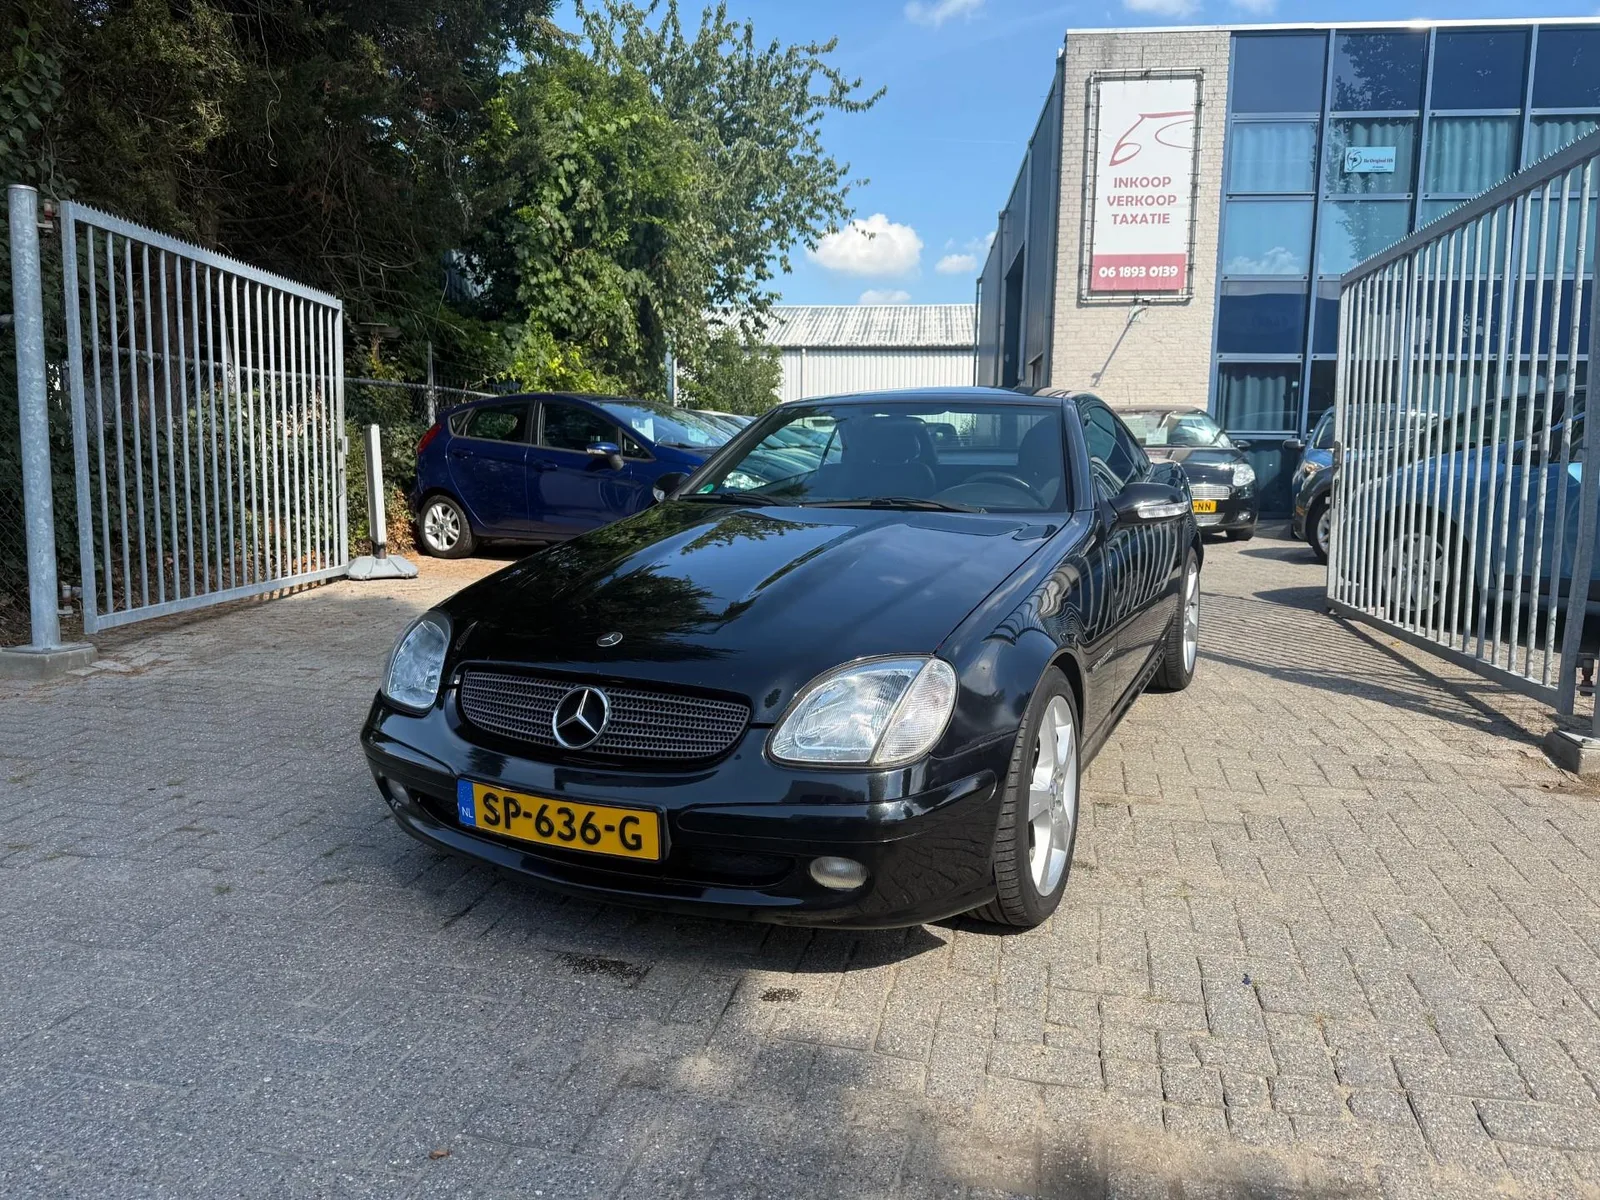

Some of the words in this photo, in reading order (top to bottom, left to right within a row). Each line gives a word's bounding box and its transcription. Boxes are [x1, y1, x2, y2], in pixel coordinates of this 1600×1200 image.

[1113, 176, 1172, 189] INKOOP
[1107, 194, 1177, 207] VERKOOP
[1111, 213, 1171, 225] TAXATIE
[1099, 266, 1116, 278] 06
[1119, 265, 1146, 278] 1893
[1149, 265, 1179, 278] 0139
[1194, 502, 1211, 511] -NN
[461, 806, 474, 818] NL
[482, 792, 643, 851] SP-636-G
